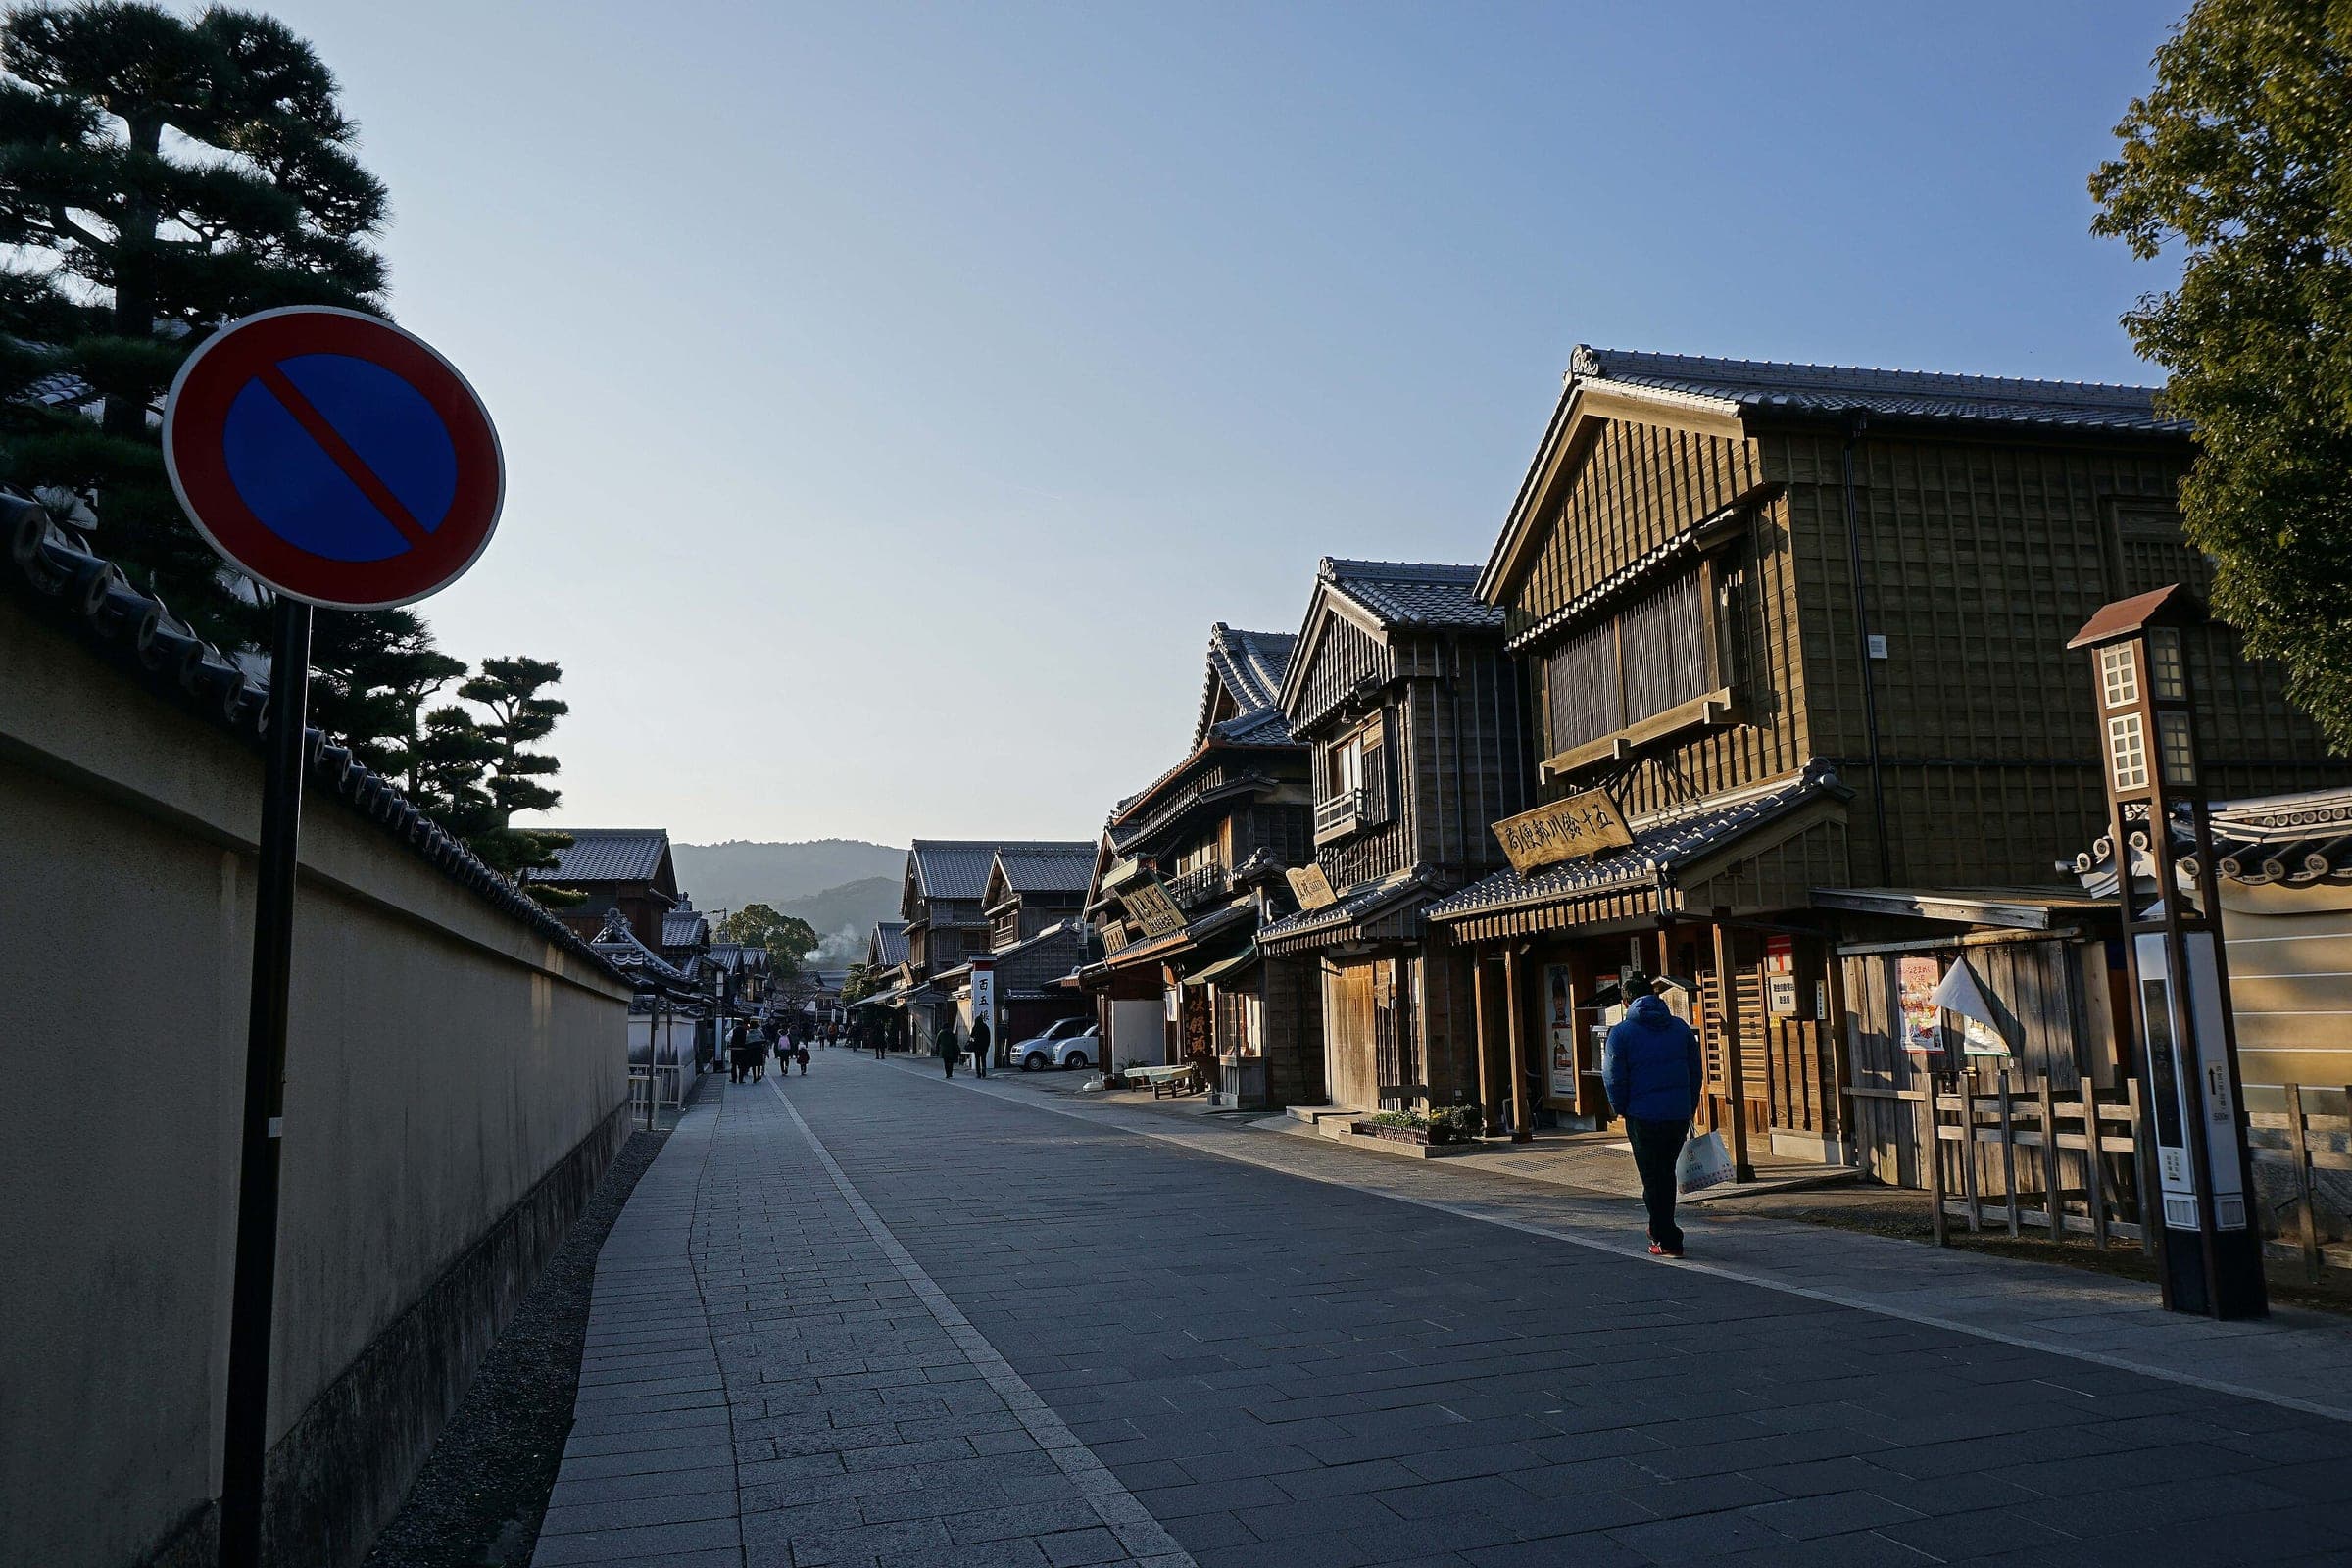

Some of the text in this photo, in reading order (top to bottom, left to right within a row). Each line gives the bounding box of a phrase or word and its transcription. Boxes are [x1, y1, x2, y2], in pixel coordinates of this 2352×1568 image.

[1505, 804, 1615, 855] 五十鈴川郵便局
